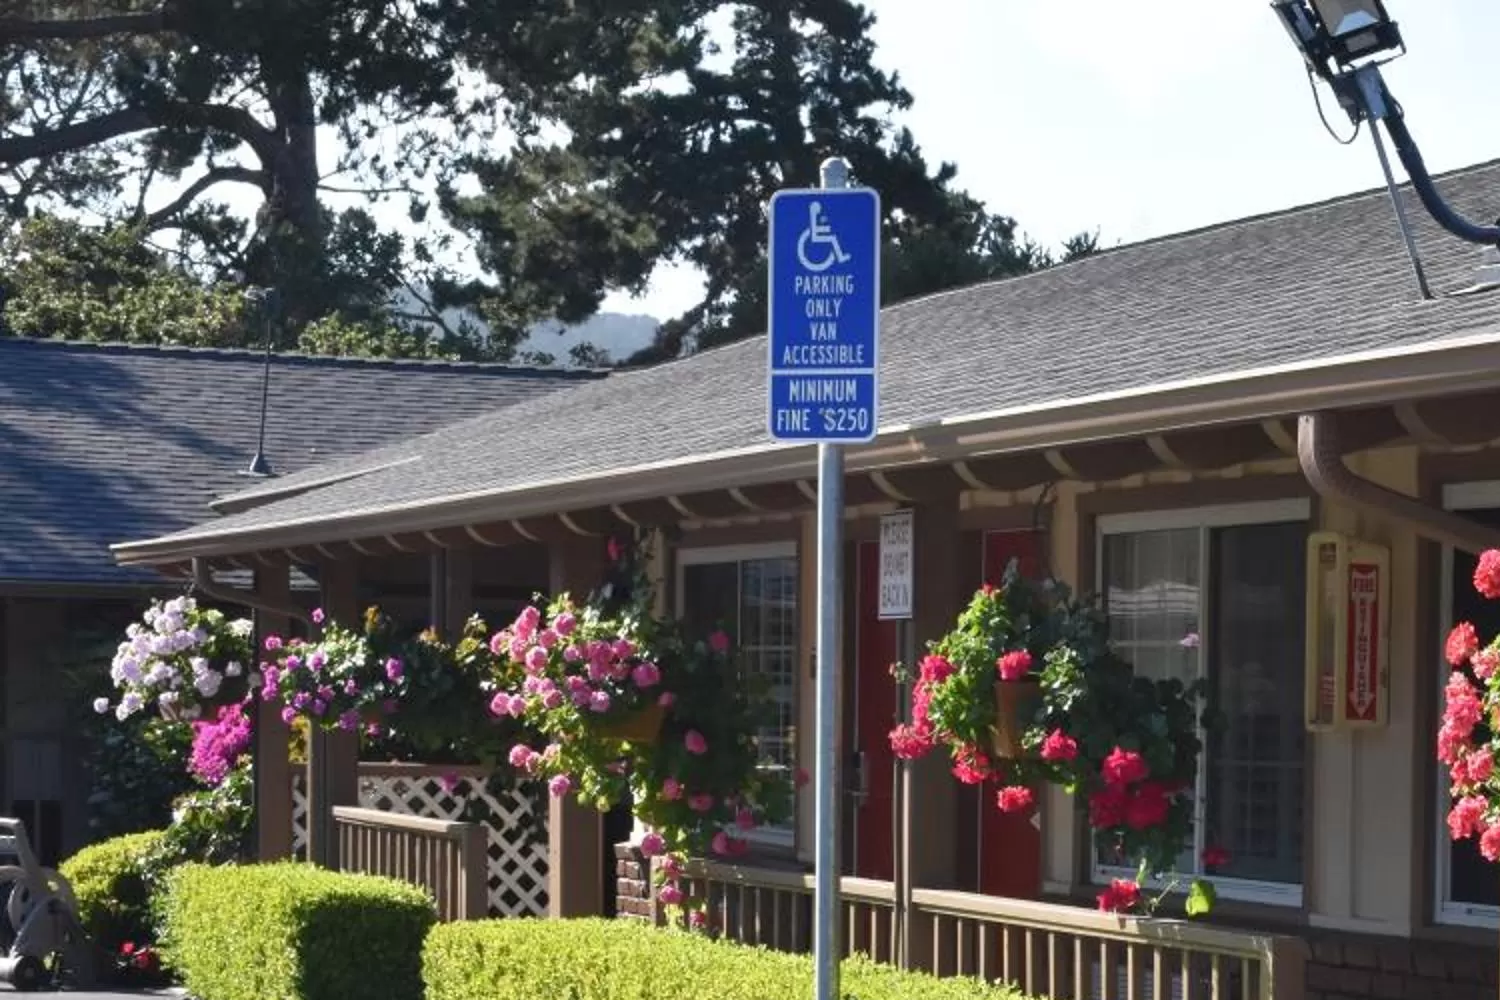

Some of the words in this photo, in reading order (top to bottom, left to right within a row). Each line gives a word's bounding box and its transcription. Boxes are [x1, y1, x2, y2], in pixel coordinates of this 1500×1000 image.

[795, 275, 854, 294] PARKING
[805, 298, 843, 318] ONLY
[809, 322, 837, 341] VAN
[783, 345, 864, 364] ACCESSIBLE
[789, 380, 856, 402] MINIMUM
[777, 409, 812, 432] FINE
